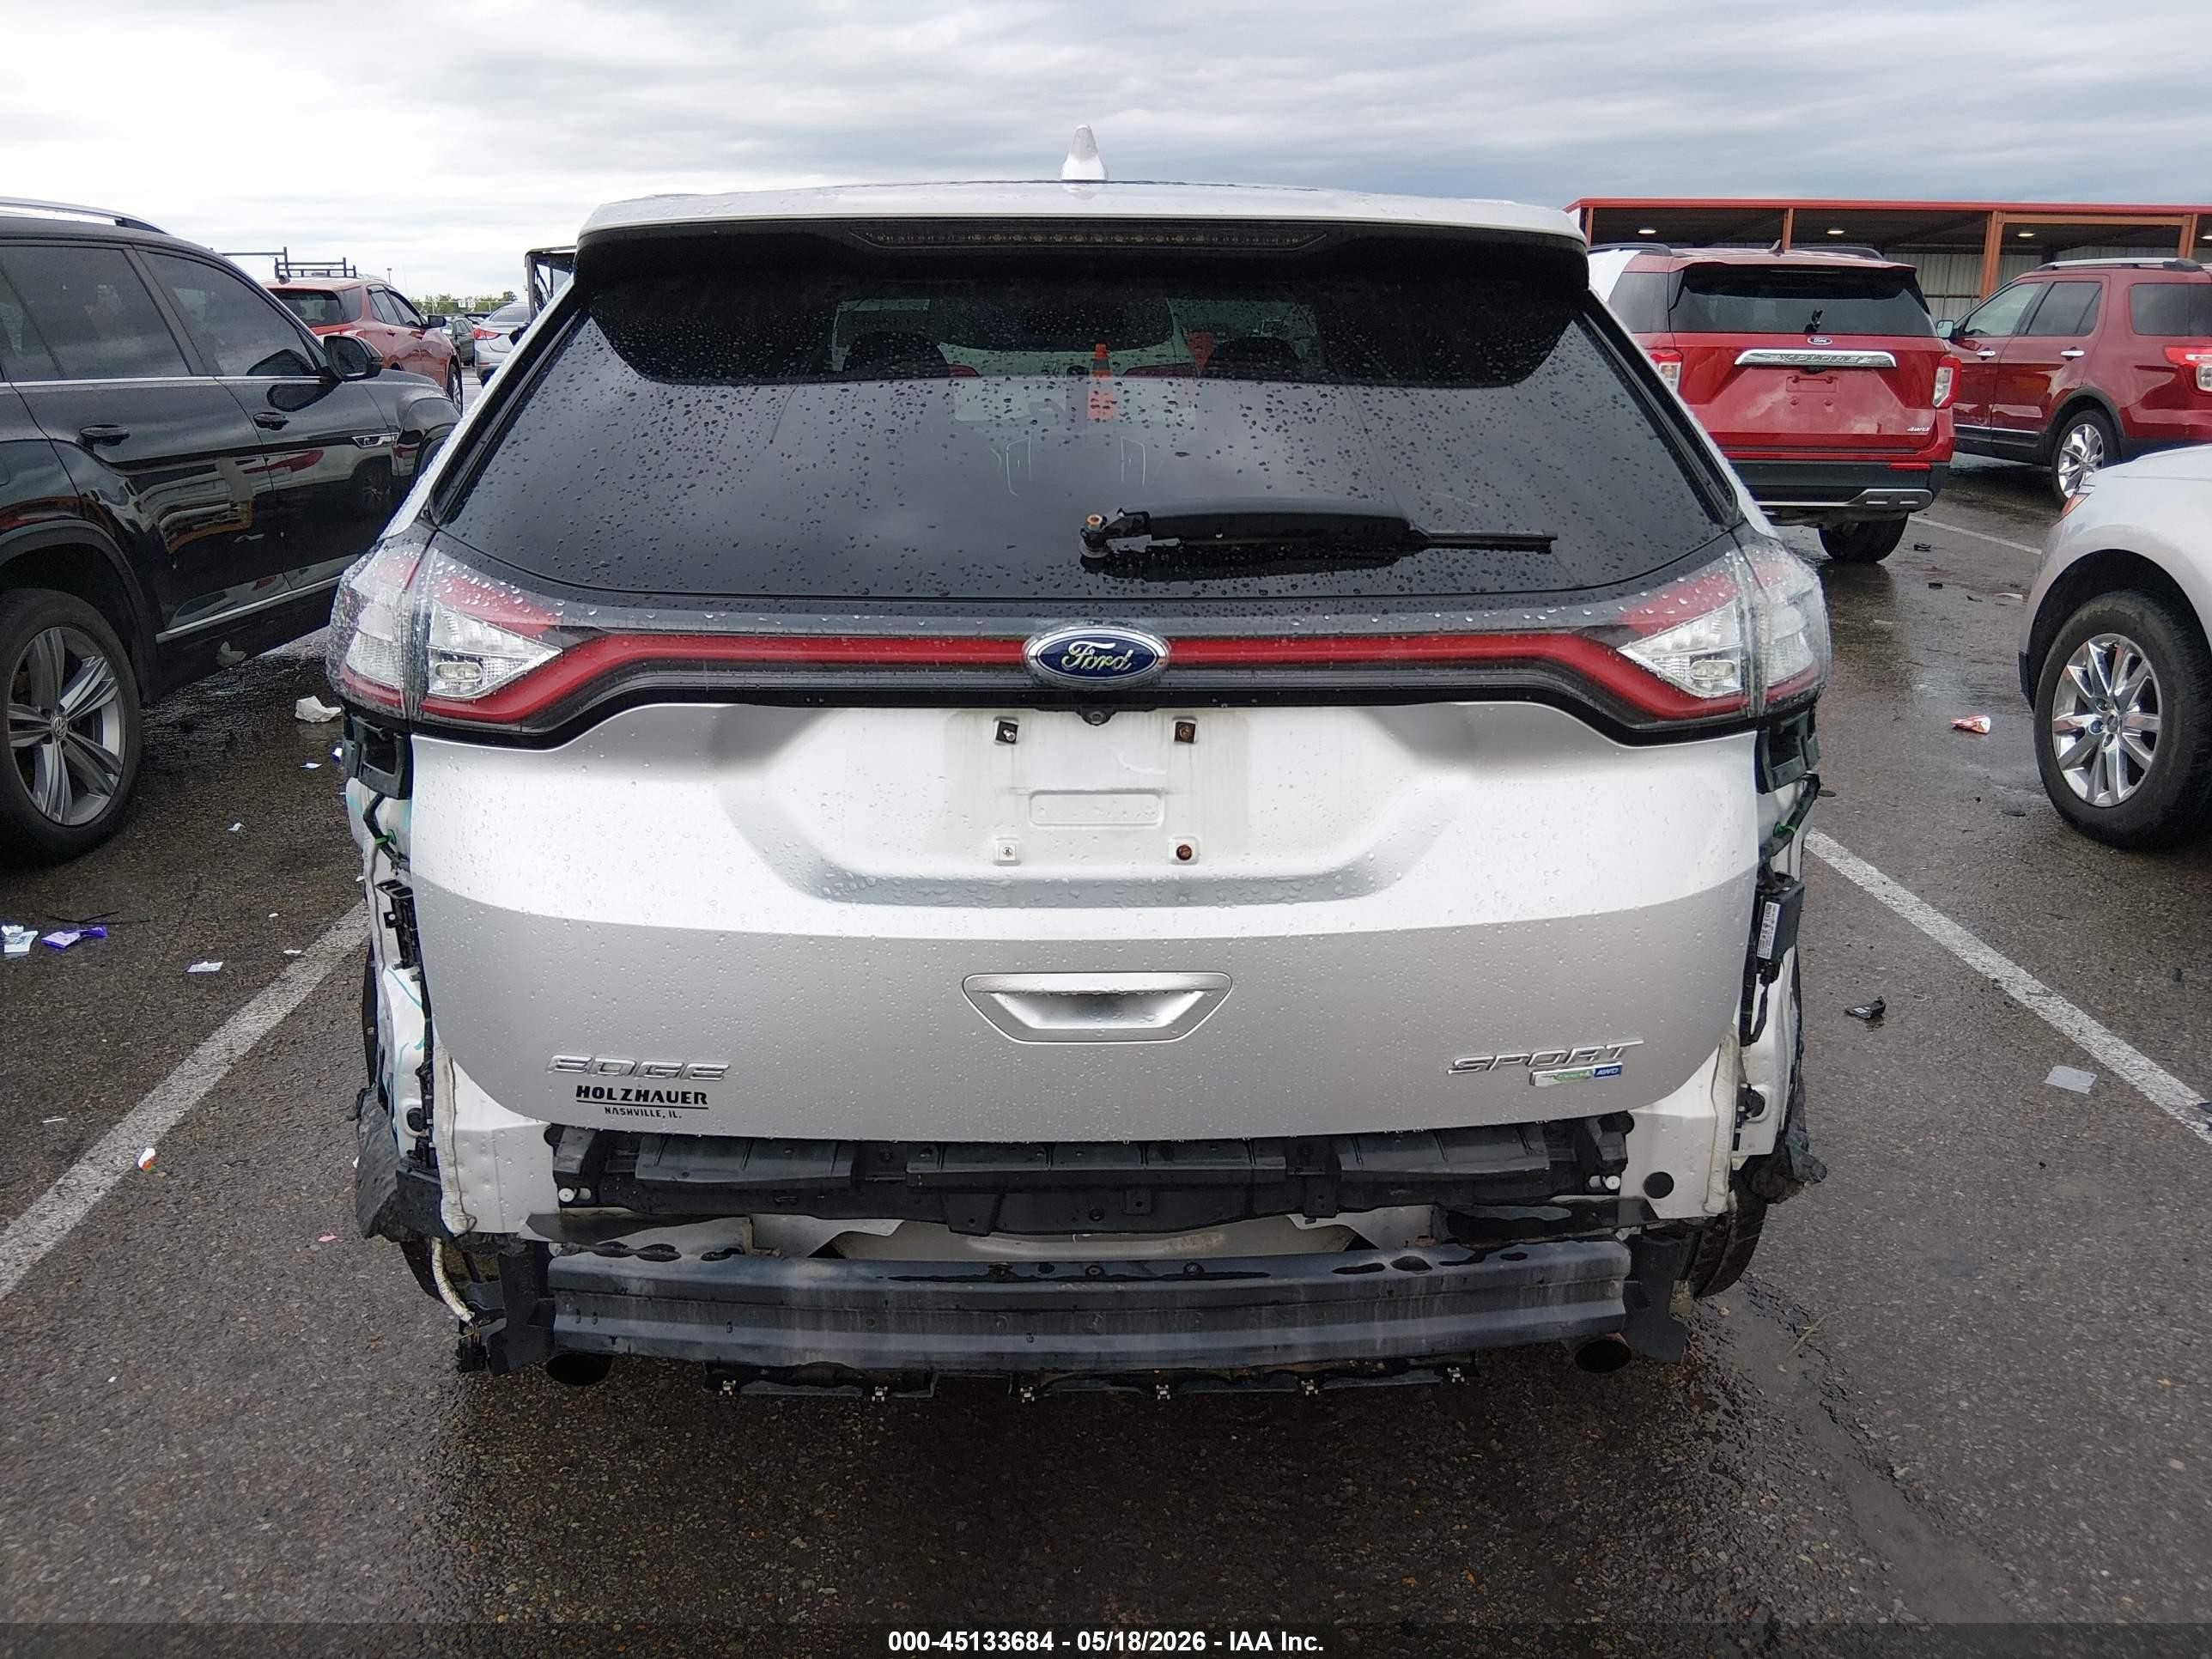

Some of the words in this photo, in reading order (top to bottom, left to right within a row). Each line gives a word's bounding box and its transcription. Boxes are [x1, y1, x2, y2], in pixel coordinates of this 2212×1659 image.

[1060, 640, 1134, 672] Ford
[547, 1054, 730, 1081] EDGE
[1447, 1039, 1644, 1074] SPORT
[1595, 1067, 1620, 1077] AWD
[575, 1085, 708, 1105] HOLZHAUER
[605, 1107, 666, 1119] NASHVILLE,
[669, 1109, 682, 1119] IL.
